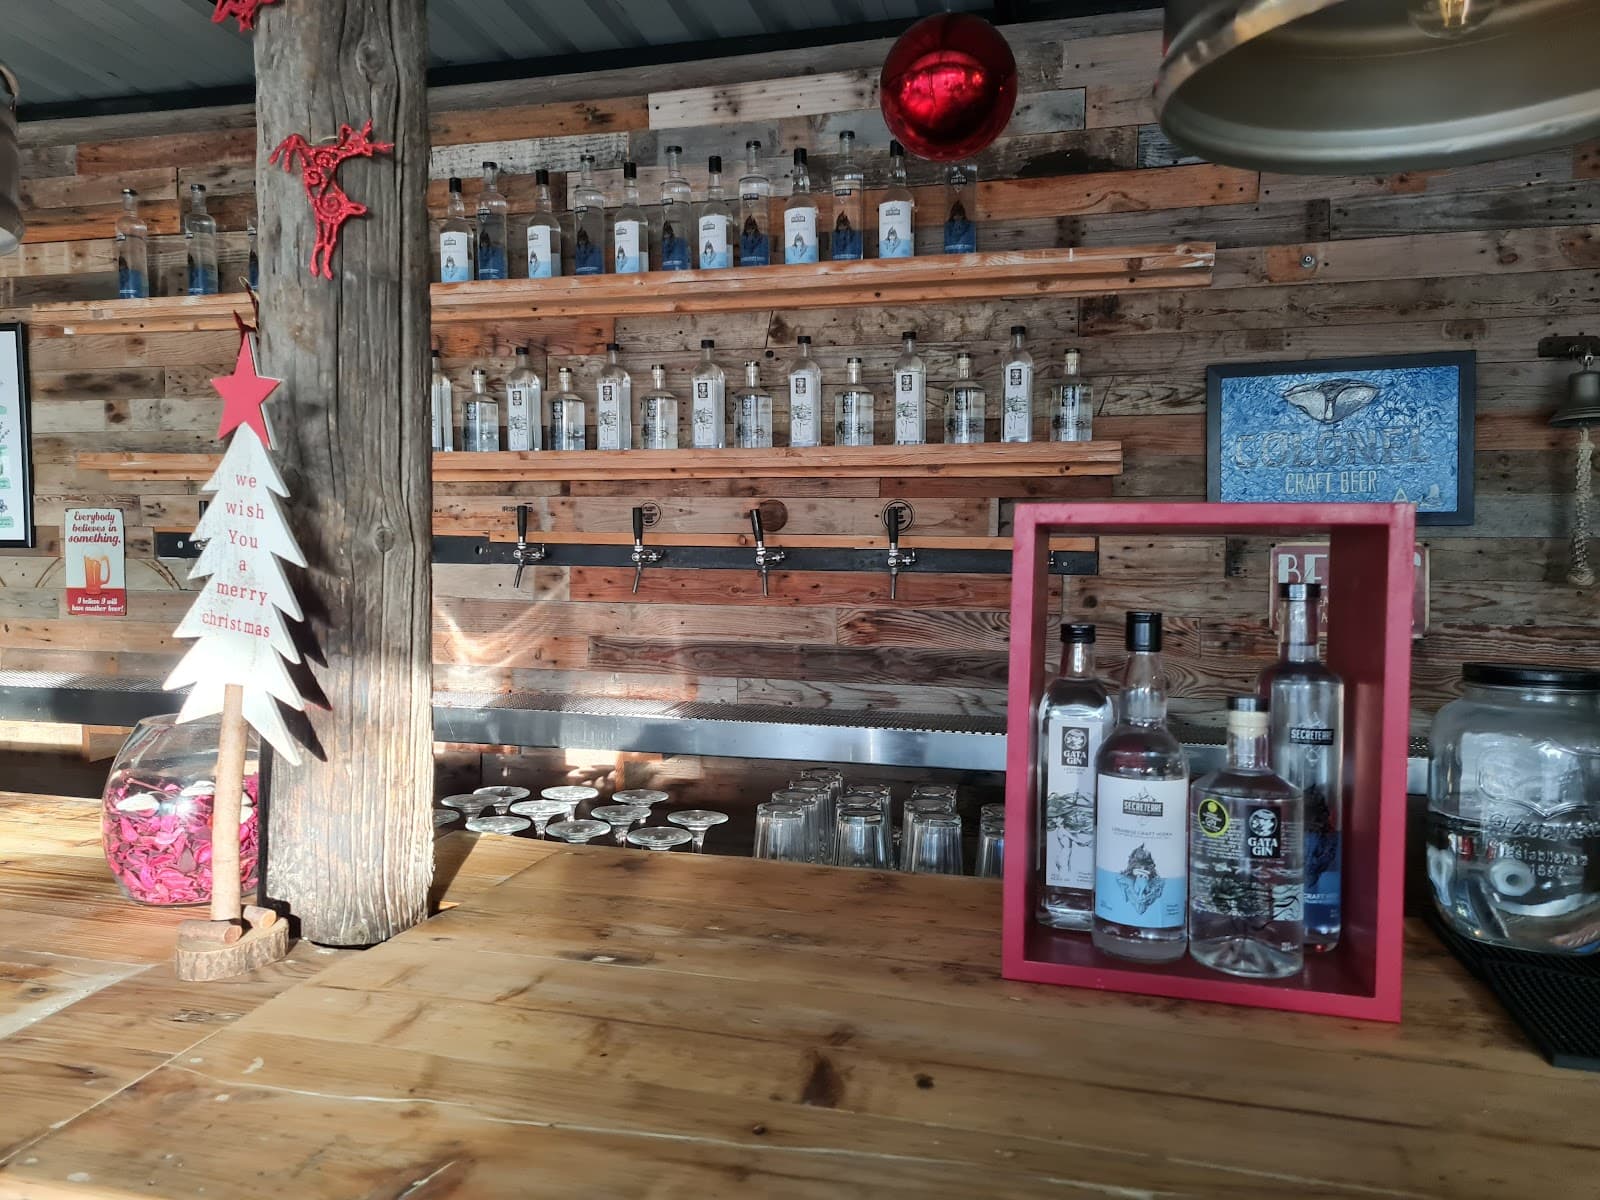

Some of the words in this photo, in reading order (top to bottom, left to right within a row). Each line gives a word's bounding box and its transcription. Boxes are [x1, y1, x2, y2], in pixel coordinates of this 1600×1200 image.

[236, 474, 257, 488] we
[1285, 472, 1332, 495] CRAFT
[1340, 470, 1377, 494] BEER
[225, 500, 264, 519] wish
[74, 511, 116, 524] Everybody
[72, 523, 106, 532] believes
[108, 523, 117, 532] in
[68, 533, 121, 547] something.
[228, 529, 258, 549] You
[239, 560, 246, 571] a
[217, 582, 268, 606] merry
[85, 604, 107, 612] another
[202, 608, 270, 638] christmas
[1063, 750, 1087, 759] GATA
[1066, 757, 1082, 766] GIN
[1247, 837, 1278, 848] GATA
[1252, 846, 1273, 856] GIN
